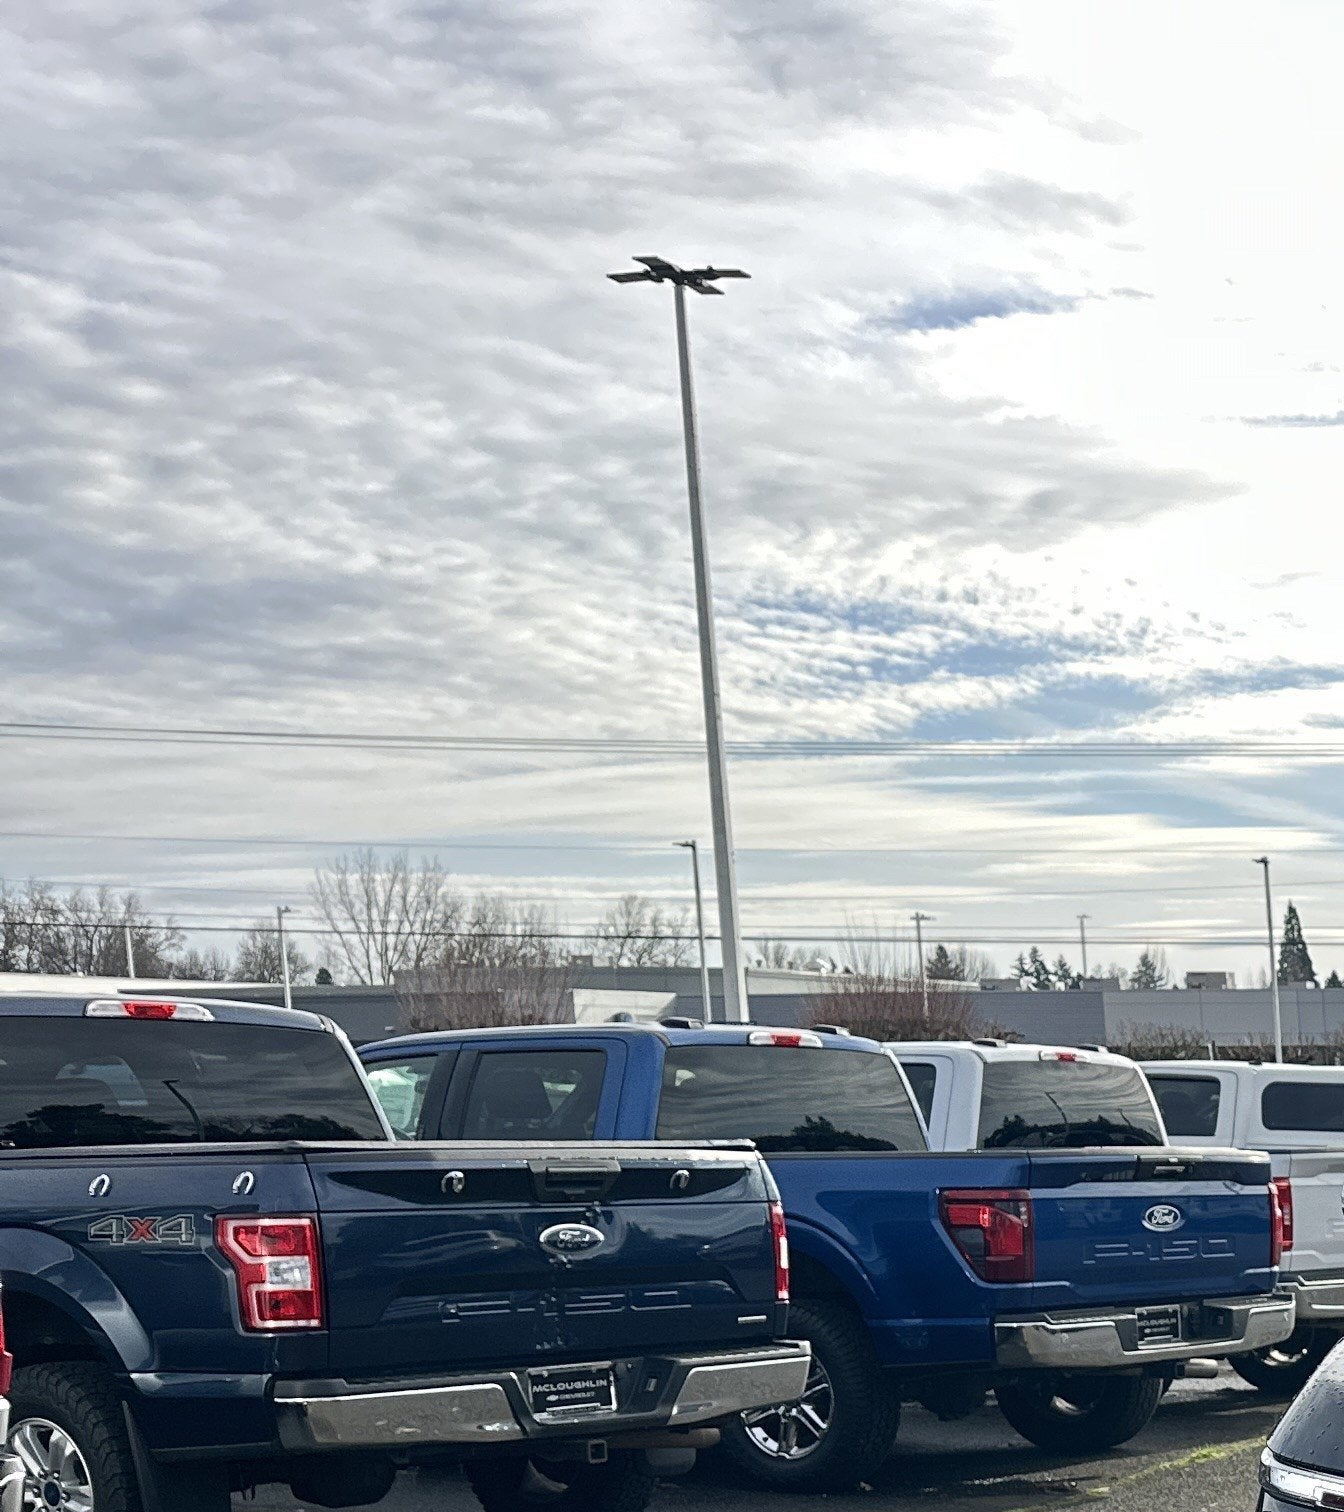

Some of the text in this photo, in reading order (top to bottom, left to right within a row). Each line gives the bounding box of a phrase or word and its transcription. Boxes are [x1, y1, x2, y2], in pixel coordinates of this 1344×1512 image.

[1082, 1239, 1236, 1265] F-150
[440, 1290, 693, 1323] F-150
[532, 1379, 607, 1393] MCLOUGHLIN
